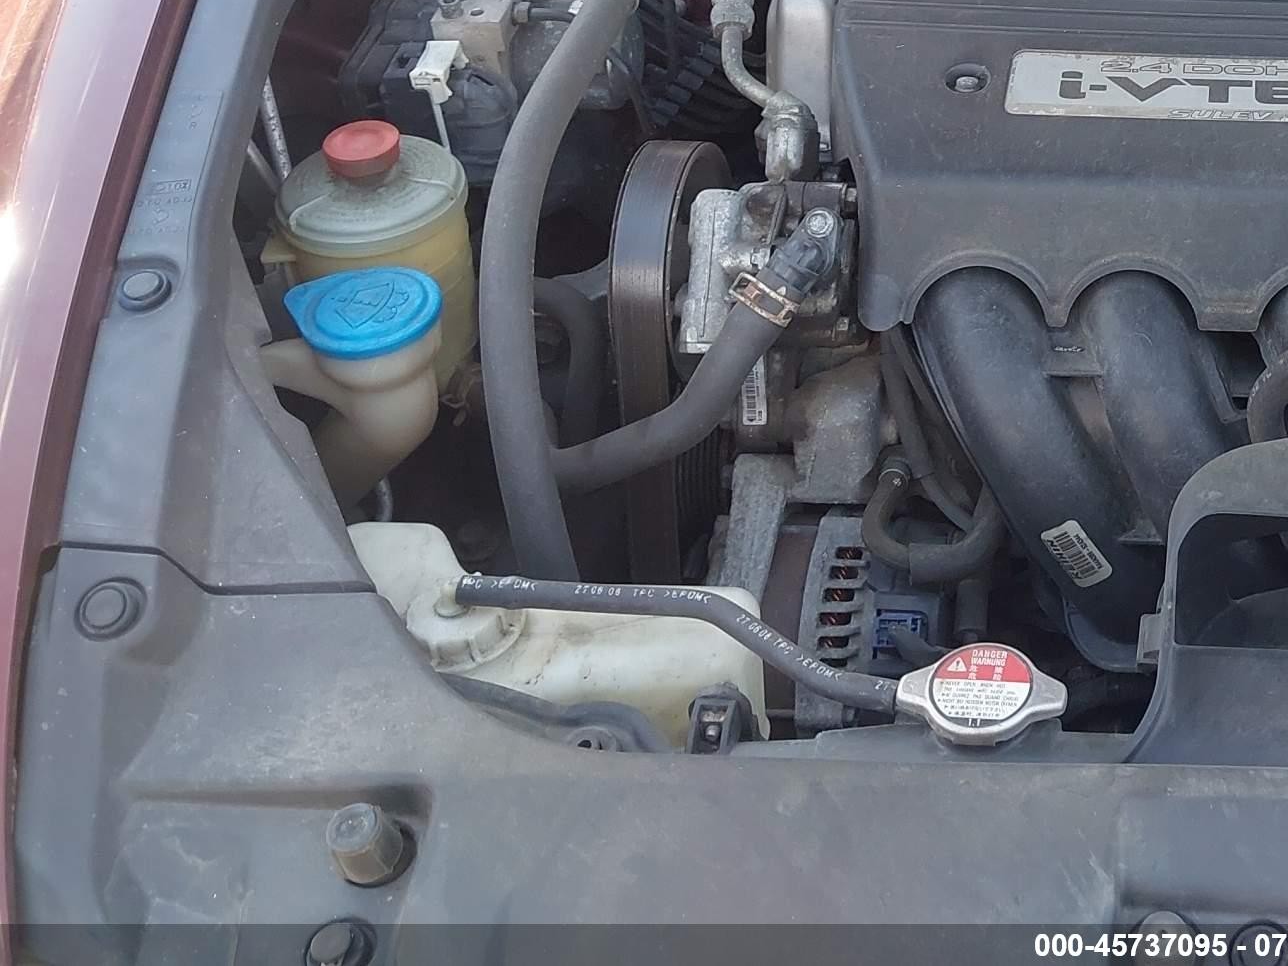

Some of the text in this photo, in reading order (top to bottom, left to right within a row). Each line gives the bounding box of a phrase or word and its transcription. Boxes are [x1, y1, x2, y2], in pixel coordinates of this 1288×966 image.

[1100, 60, 1172, 75] 2.4
[1167, 108, 1273, 121] SULEV
[972, 649, 1008, 659] DANGER
[970, 657, 1007, 667] WARNUNG
